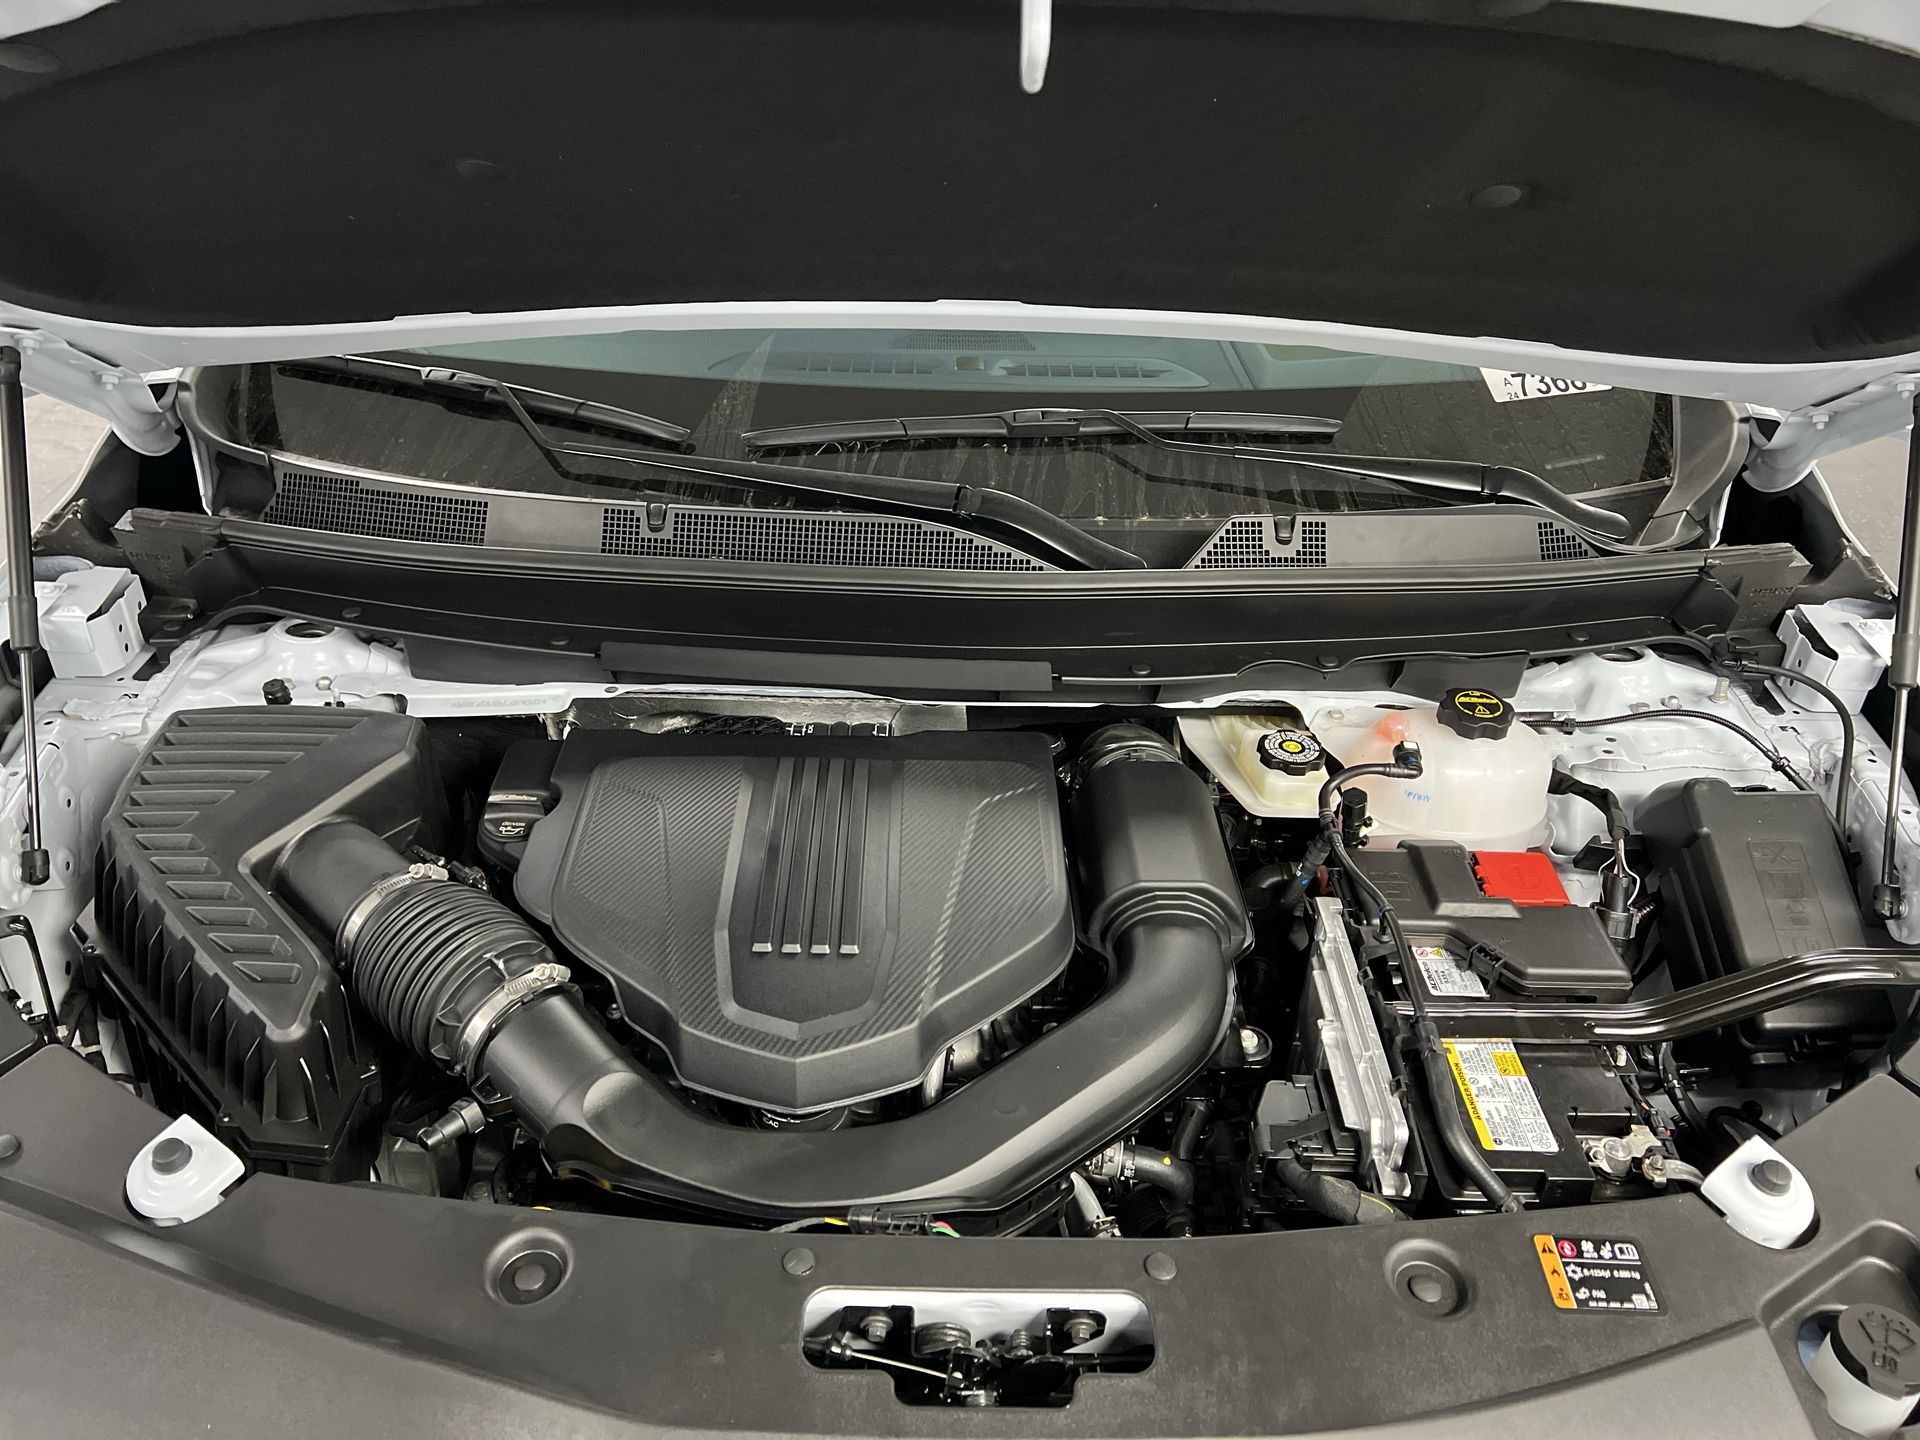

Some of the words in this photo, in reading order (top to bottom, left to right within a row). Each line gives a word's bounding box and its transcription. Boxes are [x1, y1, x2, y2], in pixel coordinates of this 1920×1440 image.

[1504, 377, 1512, 387] A
[1507, 391, 1520, 400] 24
[1422, 962, 1439, 991] ACDelco
